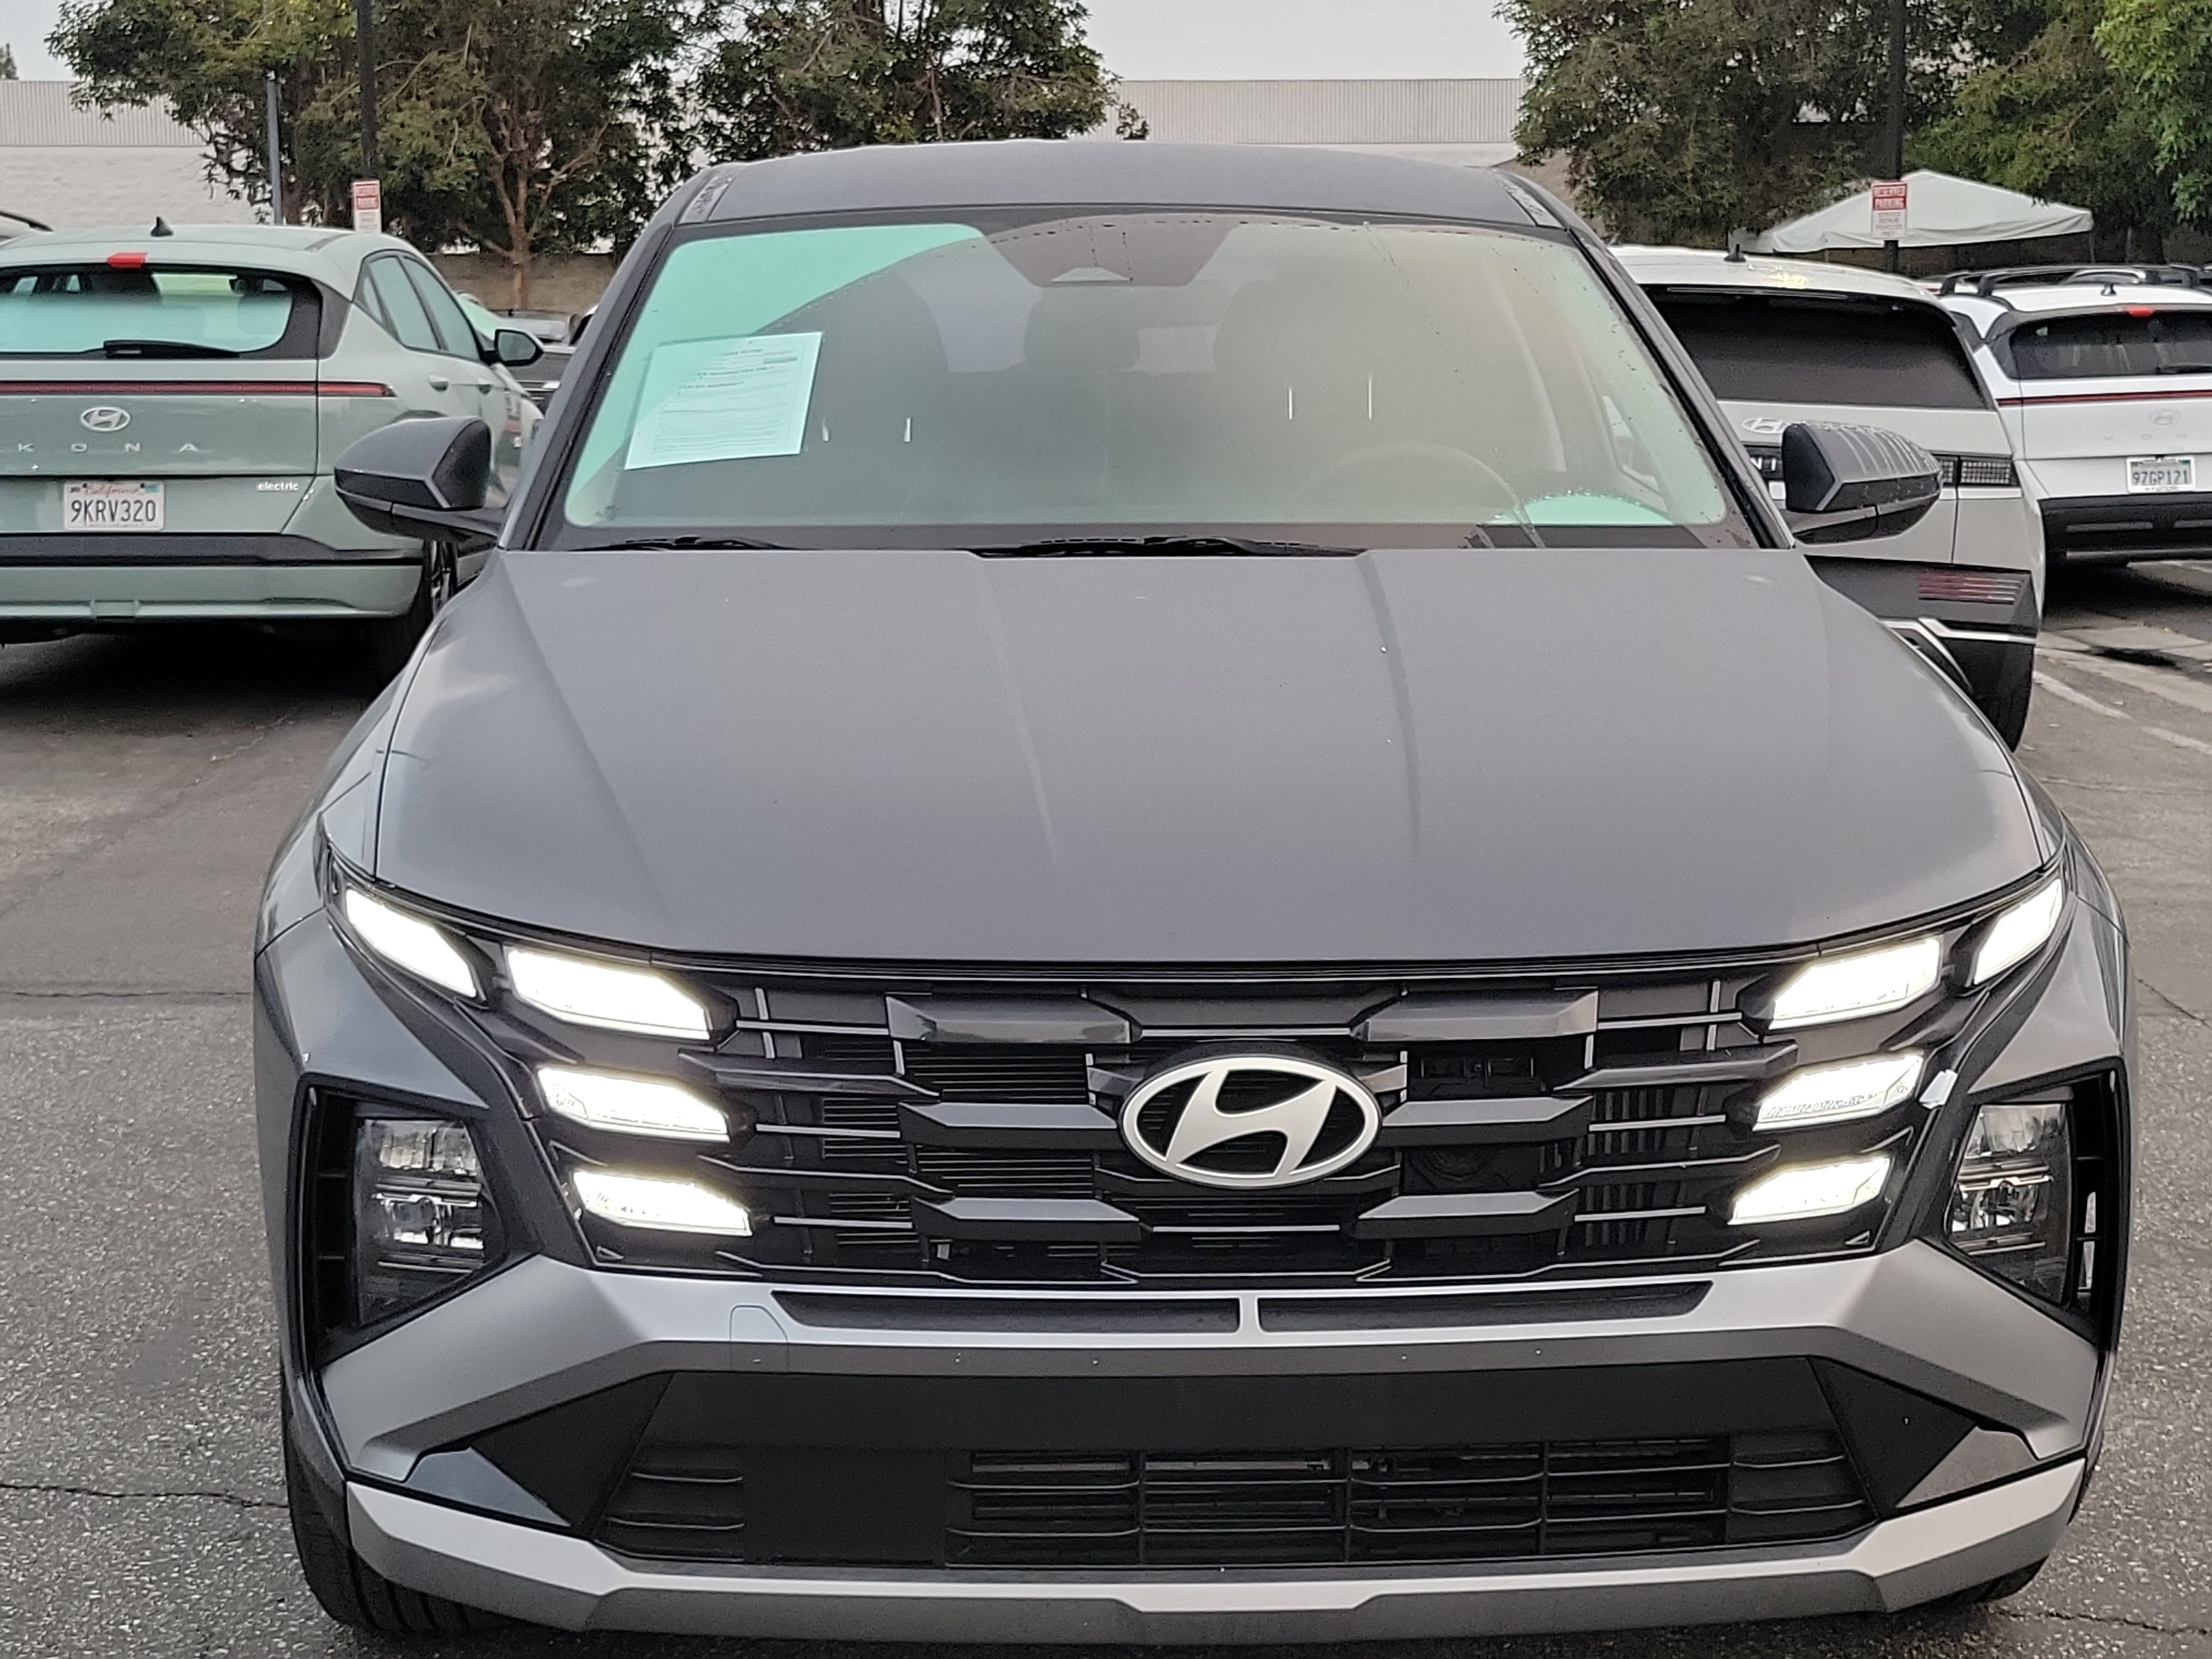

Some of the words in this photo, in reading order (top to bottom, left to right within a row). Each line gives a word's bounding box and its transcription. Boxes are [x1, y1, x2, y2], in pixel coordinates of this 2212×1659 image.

[18, 443, 199, 453] KONA
[258, 481, 299, 490] electric
[71, 500, 156, 522] 9KRV320
